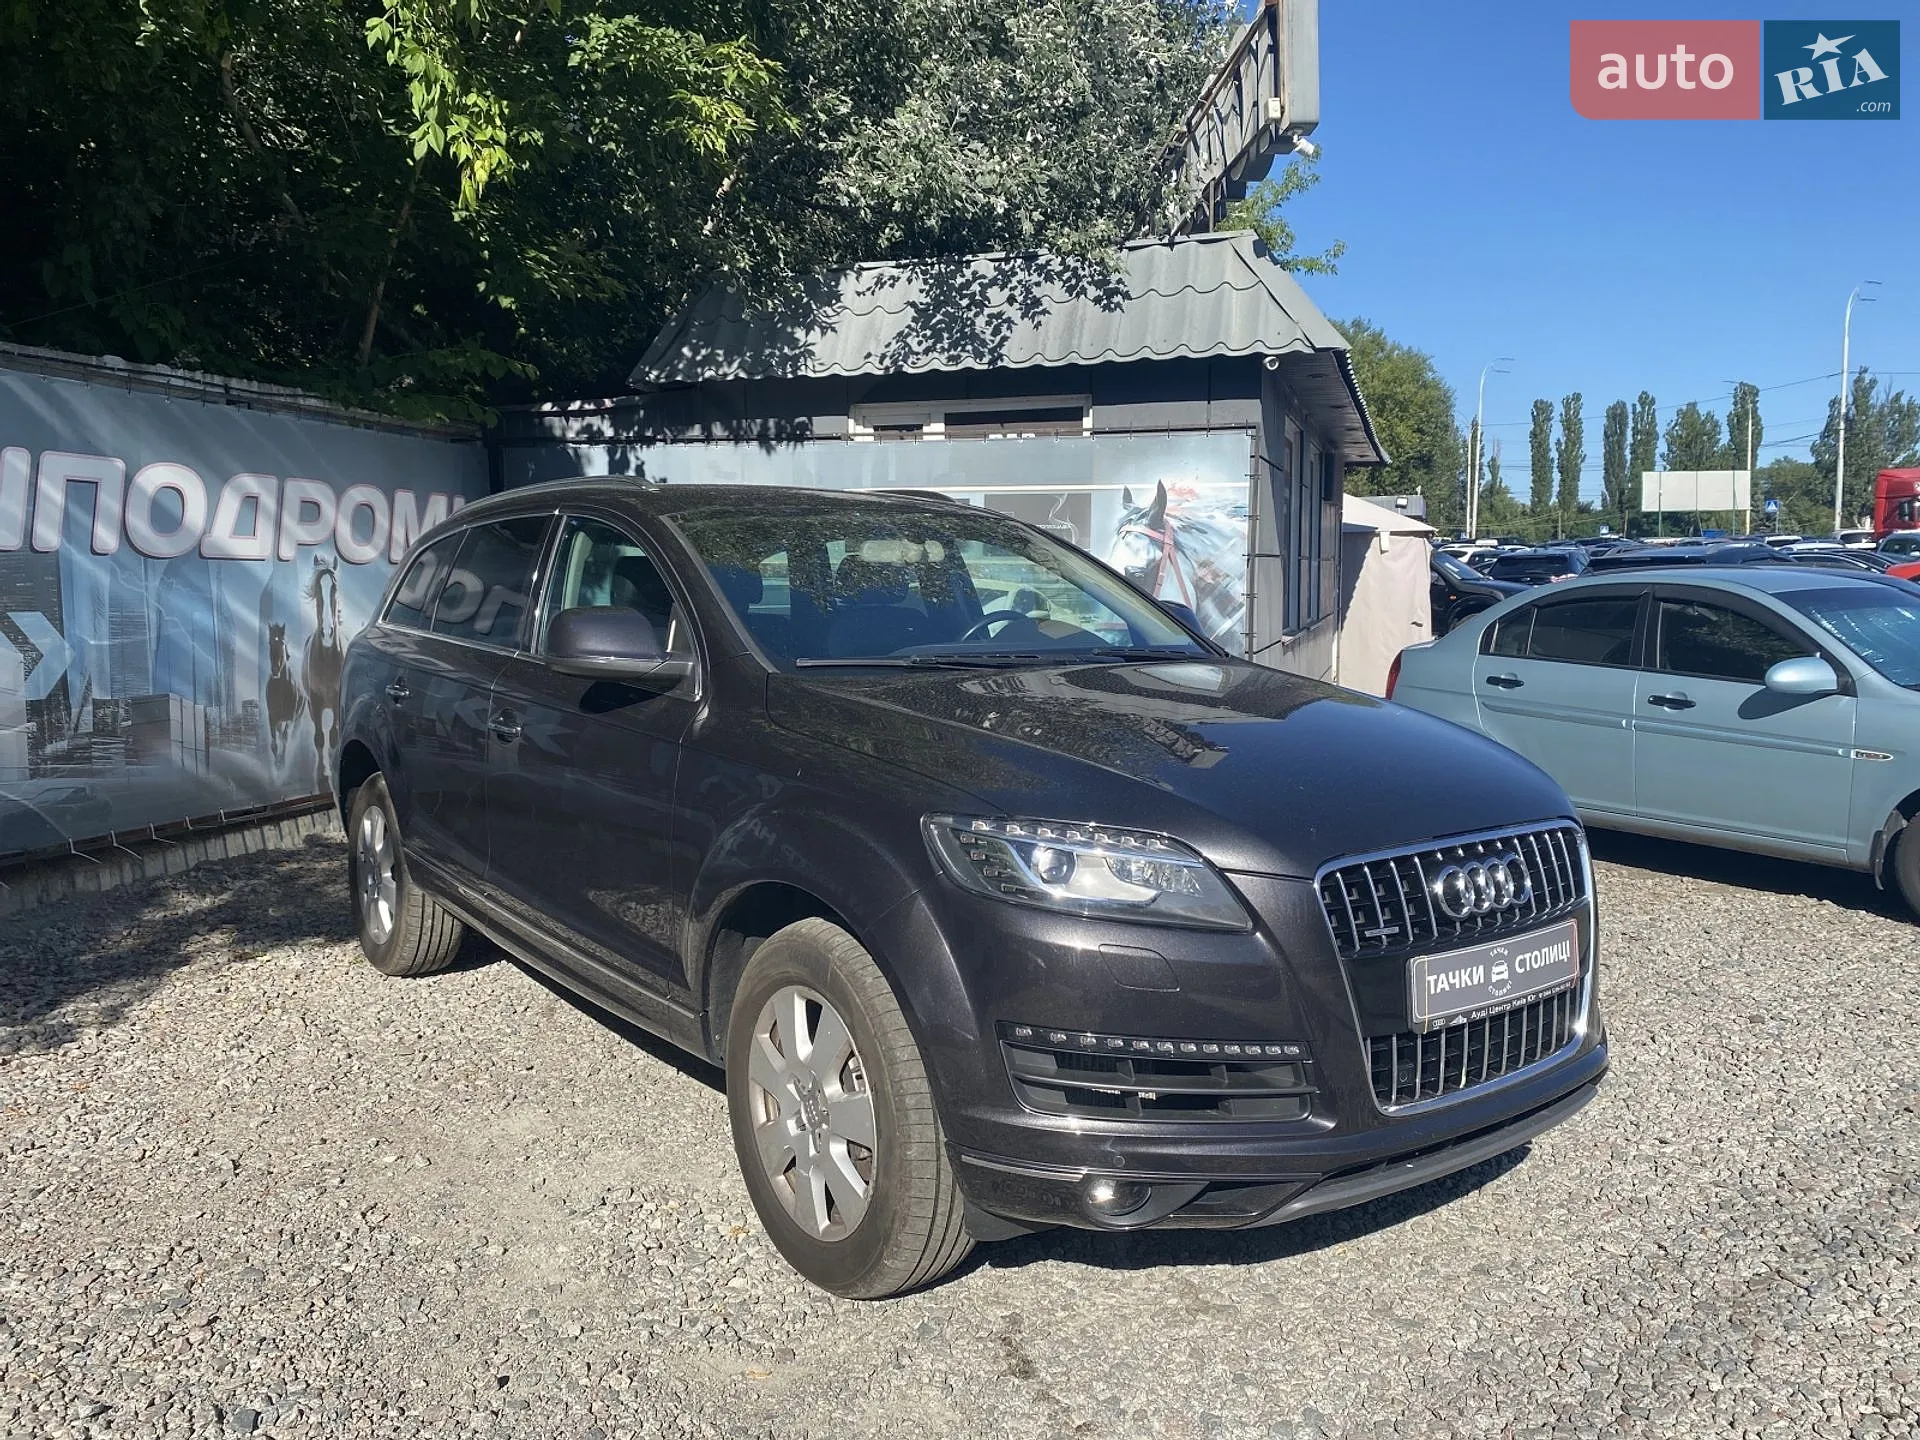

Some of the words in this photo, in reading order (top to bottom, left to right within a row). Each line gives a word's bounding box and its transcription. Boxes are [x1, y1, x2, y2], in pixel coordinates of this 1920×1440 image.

[0, 446, 468, 564] ПОДРОМ
[1427, 965, 1485, 995] ТАЧКИ
[1514, 940, 1571, 974] СТОЛИЦІ
